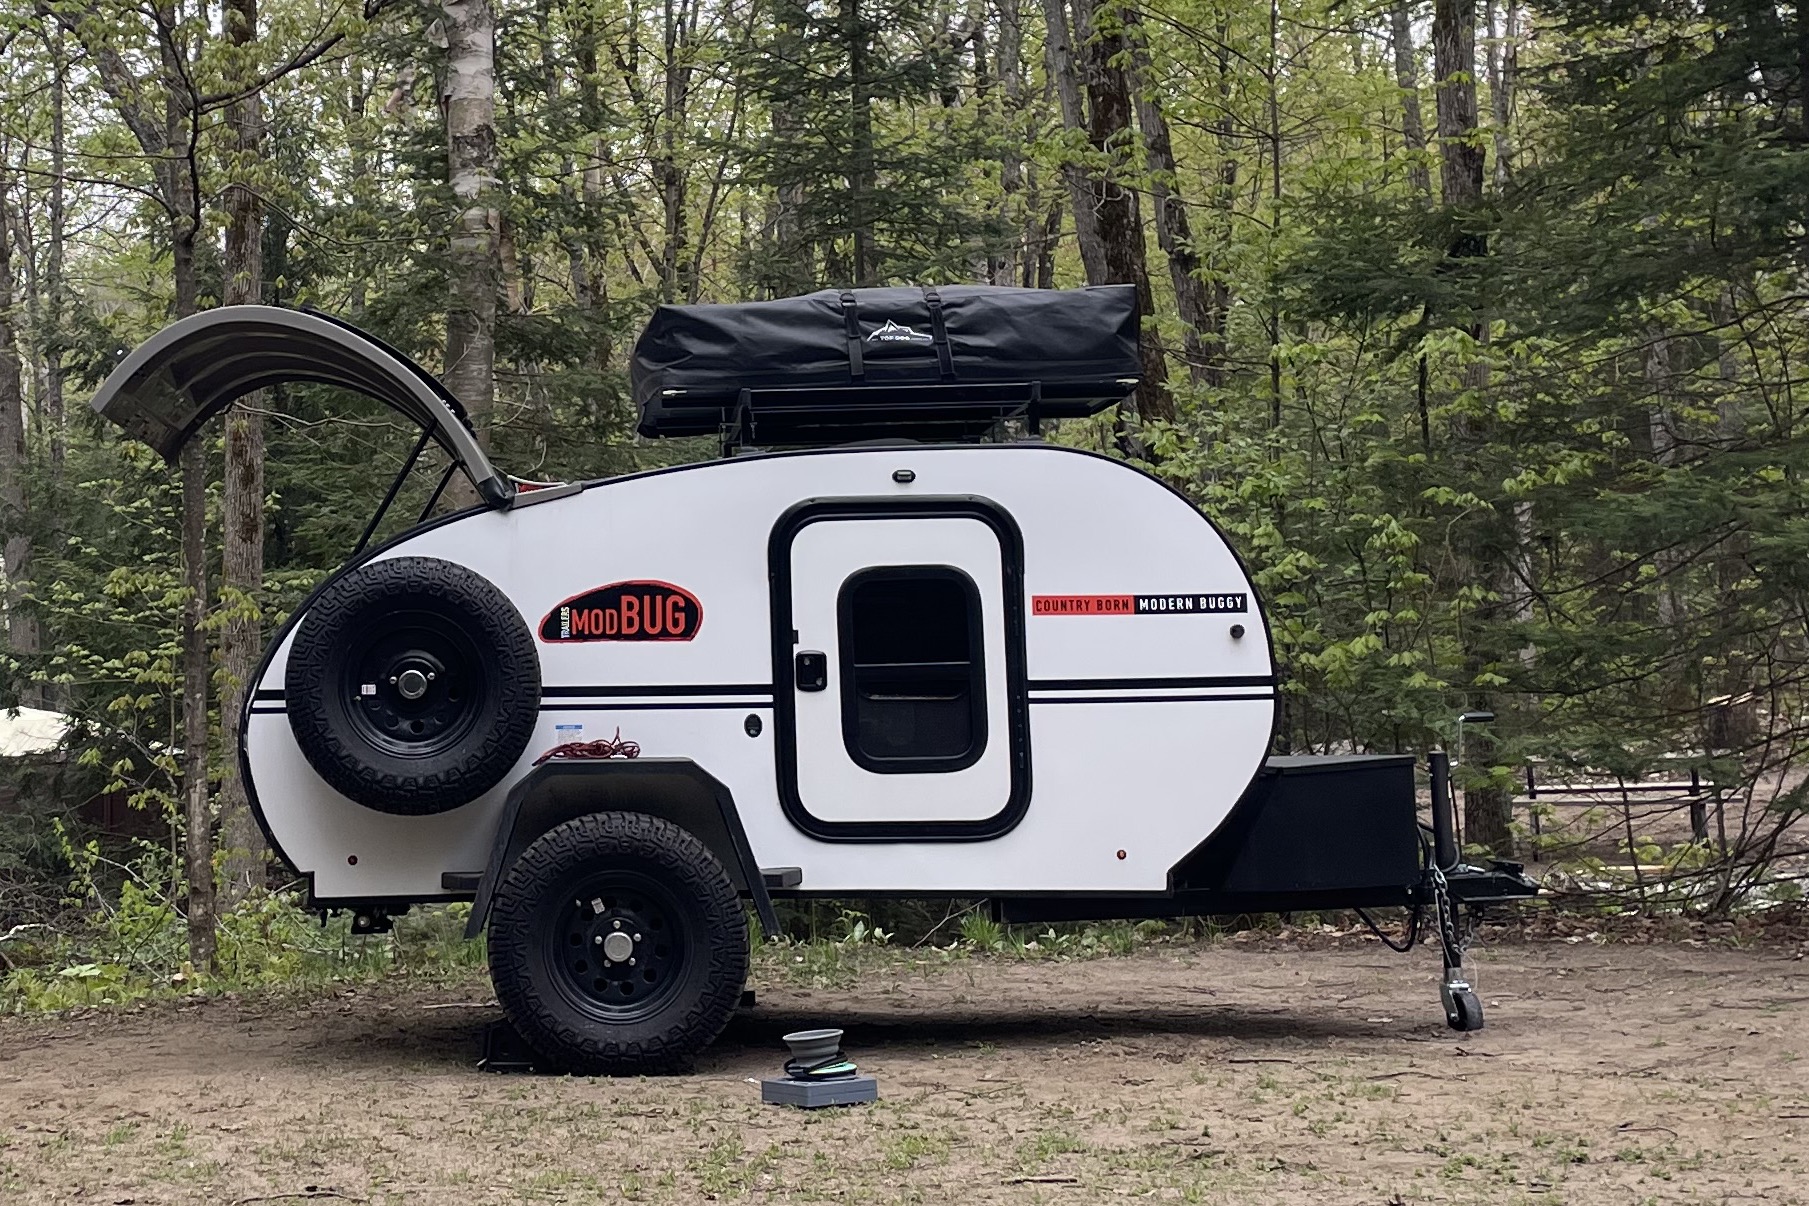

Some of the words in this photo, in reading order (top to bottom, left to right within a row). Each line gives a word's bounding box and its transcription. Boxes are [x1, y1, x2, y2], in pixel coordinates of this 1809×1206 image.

[1035, 599, 1090, 612] COUNTRY
[1096, 598, 1129, 611] BORN
[1139, 597, 1193, 611] MODERN
[1199, 596, 1242, 609] BUGGY
[560, 606, 571, 639] TRAILERS
